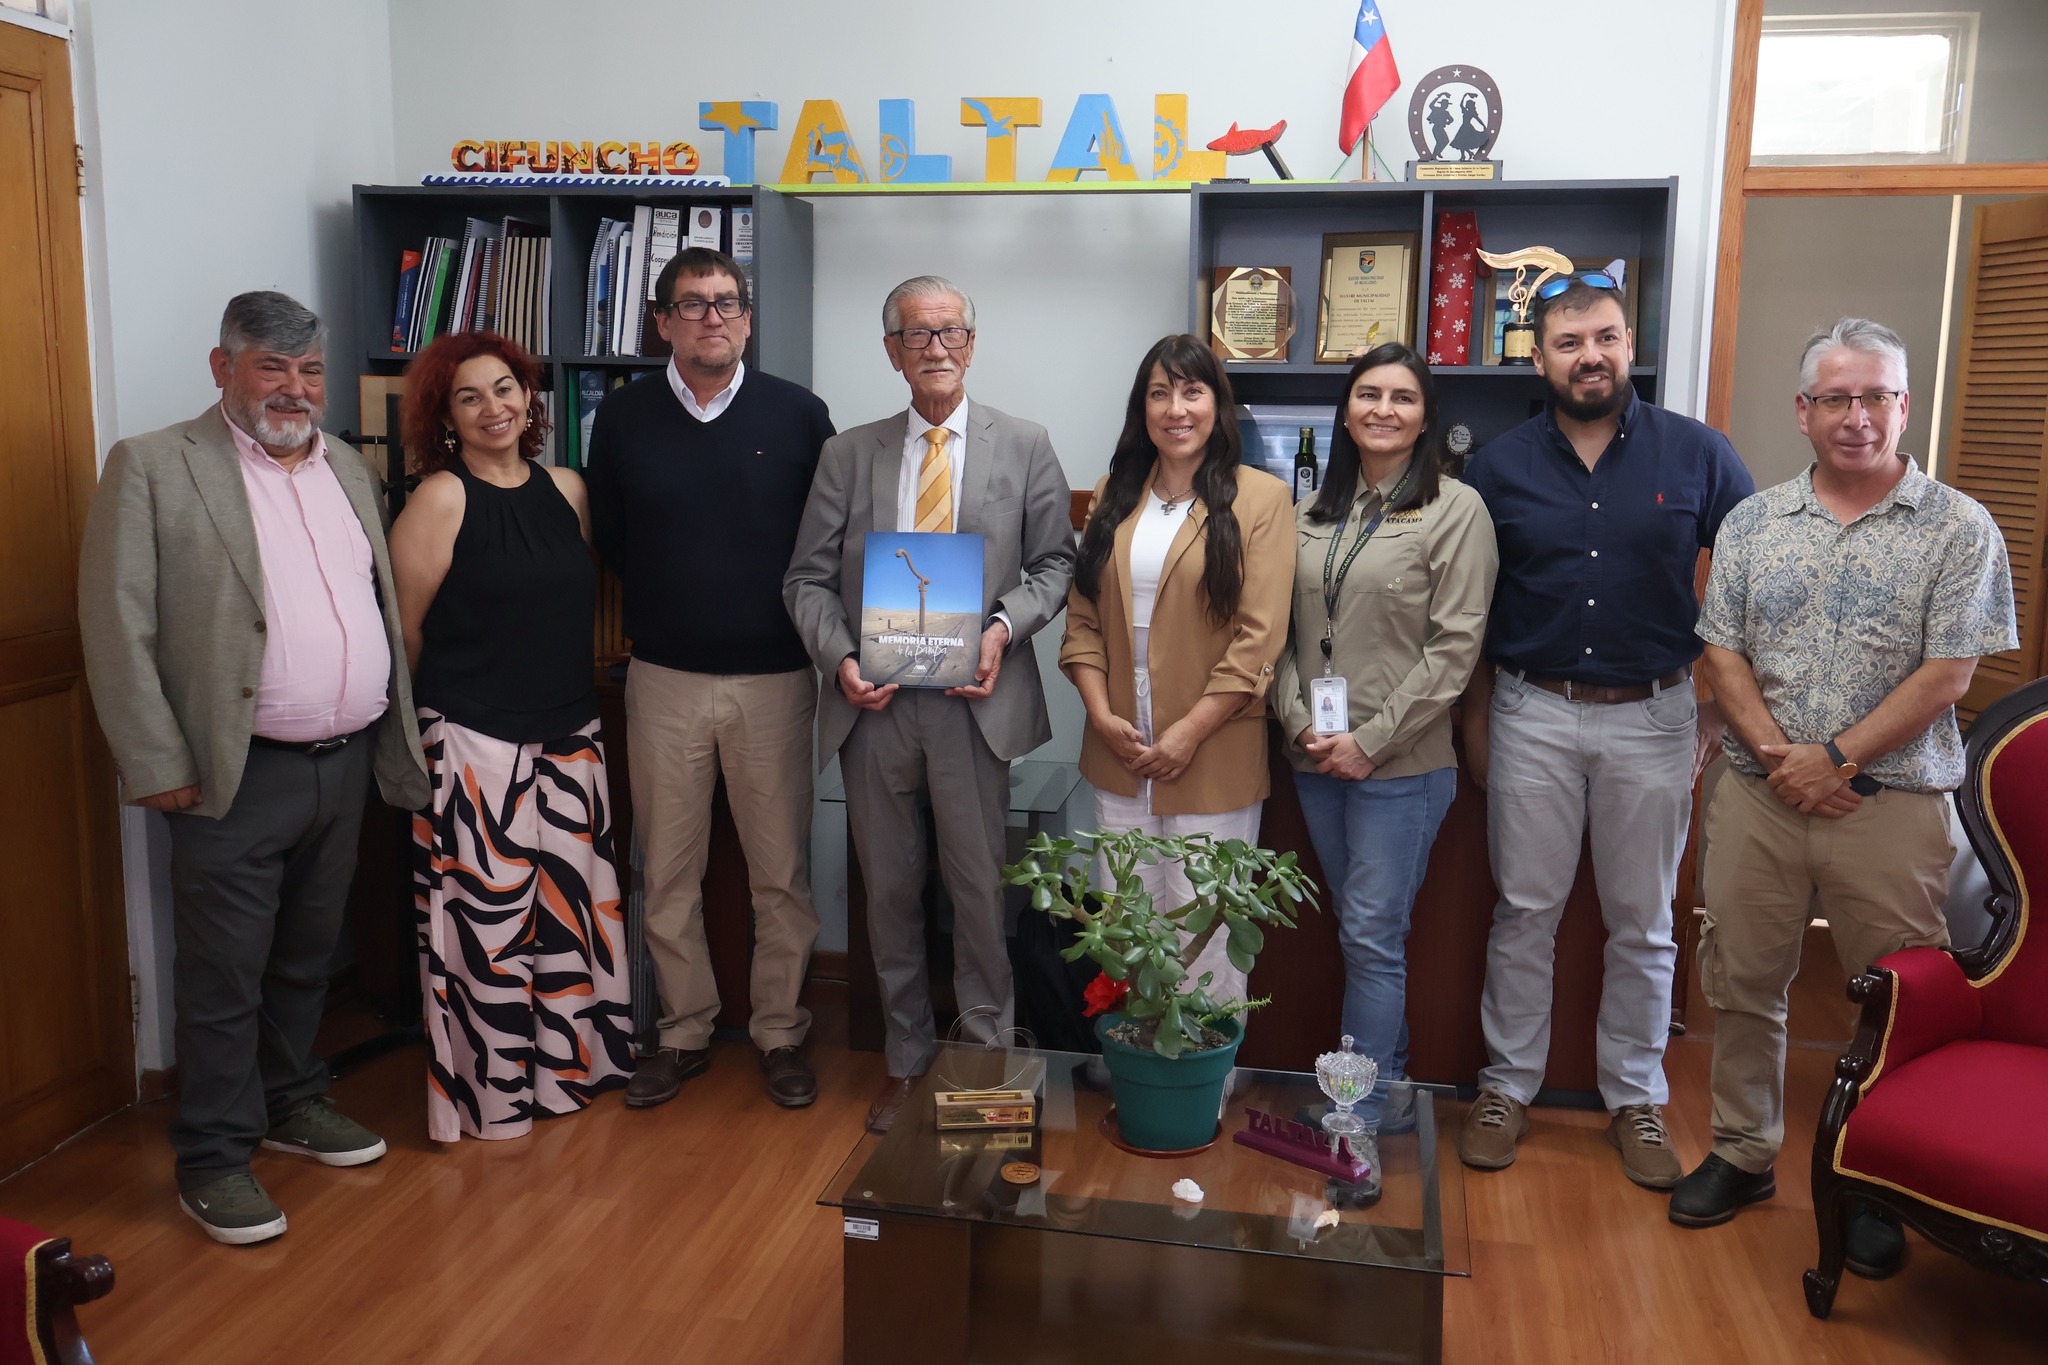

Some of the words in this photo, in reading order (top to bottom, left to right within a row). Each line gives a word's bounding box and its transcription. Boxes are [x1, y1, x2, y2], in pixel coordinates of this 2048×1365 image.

[699, 93, 1227, 184] TALTAL
[450, 139, 700, 176] CIFUNCHO
[655, 210, 678, 218] auca
[1337, 555, 1354, 579] ATACAMA
[1350, 531, 1371, 556] MINERALS
[879, 635, 927, 645] MEMORIA
[928, 638, 964, 647] ETERNA
